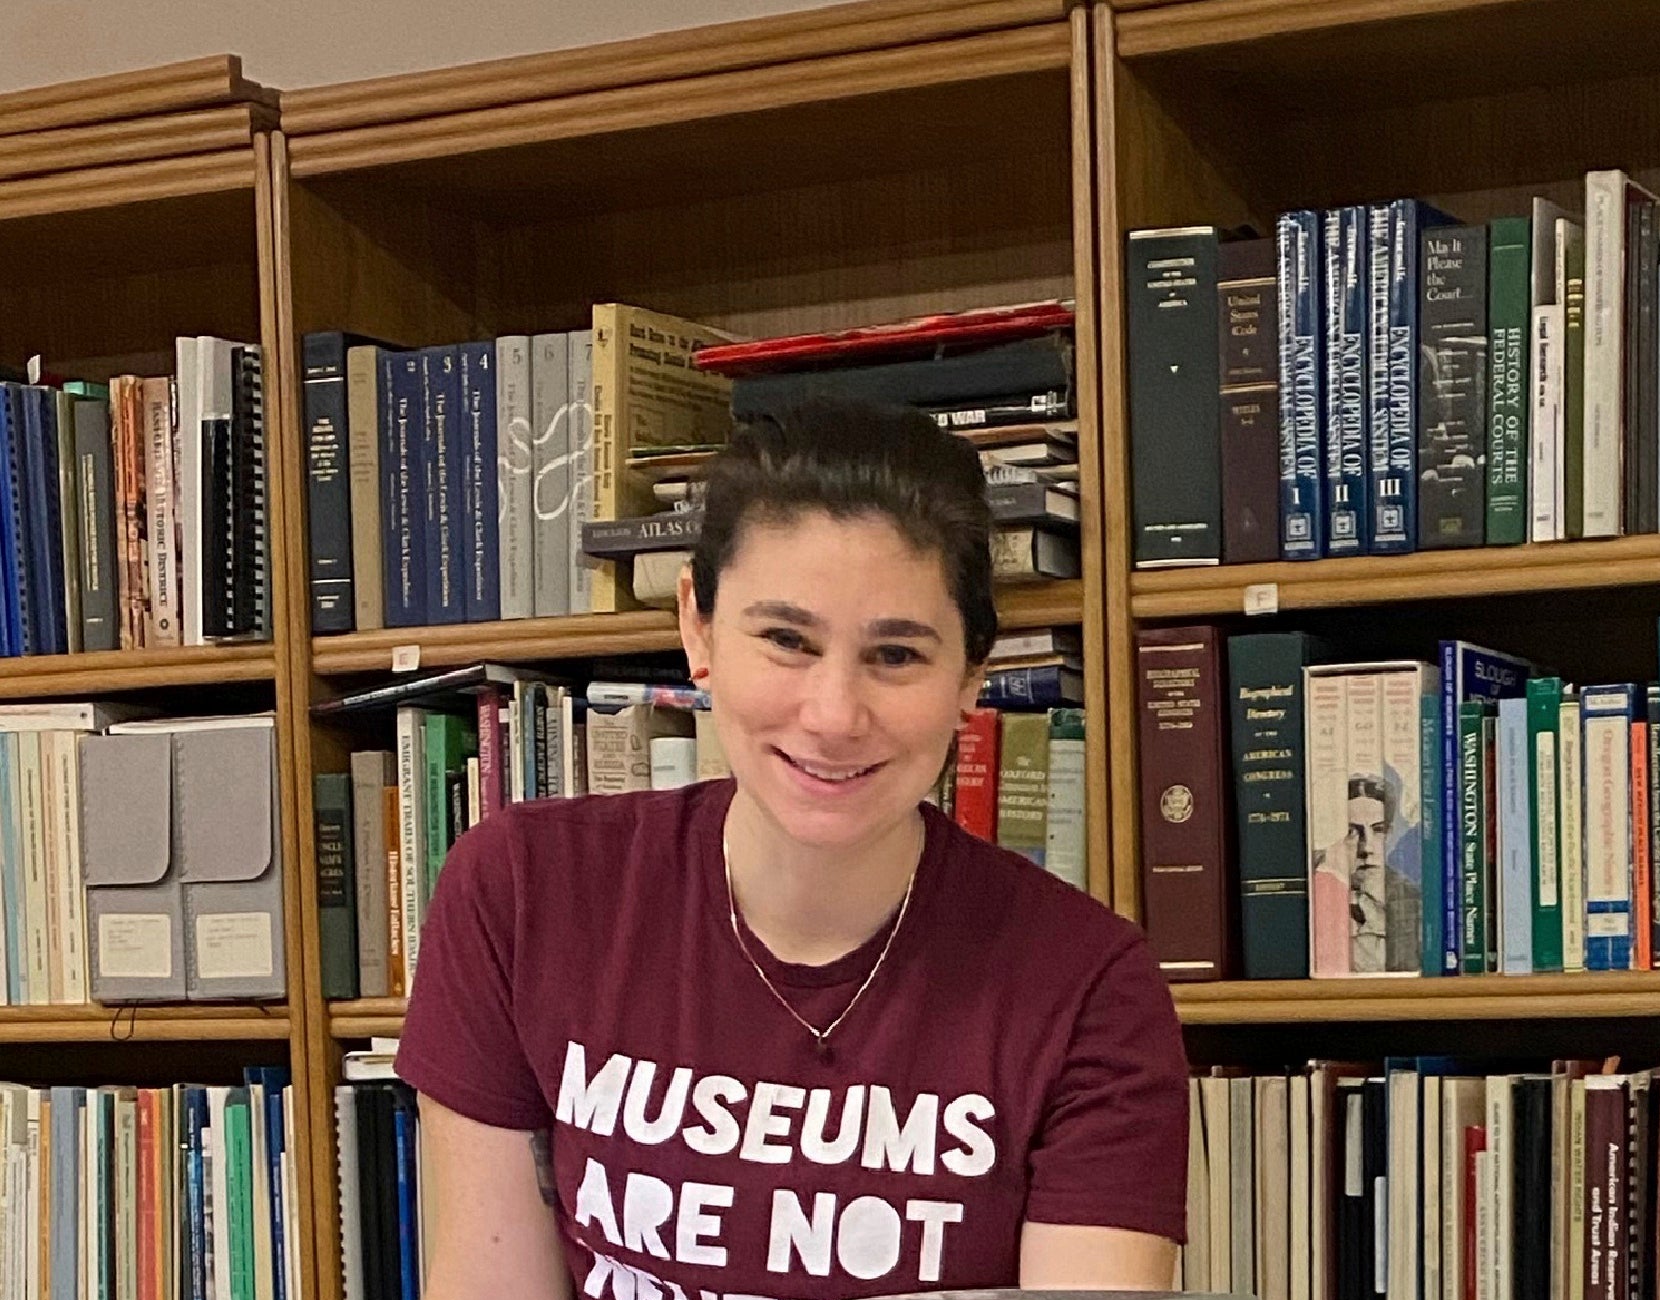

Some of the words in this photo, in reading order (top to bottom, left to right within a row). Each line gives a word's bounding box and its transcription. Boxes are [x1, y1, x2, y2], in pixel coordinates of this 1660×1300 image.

[1427, 256, 1463, 270] Please
[1427, 273, 1445, 285] the
[1427, 288, 1462, 301] Court
[479, 353, 489, 370] 4
[1494, 328, 1507, 408] FEDERAL
[1506, 328, 1520, 407] HISTORY
[1295, 336, 1316, 450] ENCYCLOPEDIA
[1342, 334, 1361, 449] ENCYCLOPEDIA
[1390, 326, 1410, 444] ENCYCLOPEDIA
[1505, 416, 1519, 440] OF
[1391, 449, 1410, 472] OF
[1492, 409, 1506, 484] COURTS
[1295, 456, 1316, 480] OF
[1343, 455, 1361, 478] OF
[1505, 447, 1519, 483] THE
[1380, 479, 1400, 497] III
[637, 521, 683, 540] ATLAS
[1464, 732, 1477, 836] WASHINGTON
[405, 847, 414, 865] OF
[1465, 842, 1476, 870] State
[1465, 872, 1477, 904] Place
[1465, 907, 1477, 945] Names
[556, 1041, 996, 1176] MUSEUMS
[1607, 1143, 1619, 1204] American
[1590, 1187, 1601, 1213] and
[575, 1157, 734, 1267] ARE
[767, 1189, 964, 1282] NOT
[1590, 1216, 1601, 1246] Trust
[1607, 1207, 1618, 1248] Indian
[1590, 1250, 1601, 1285] Areas
